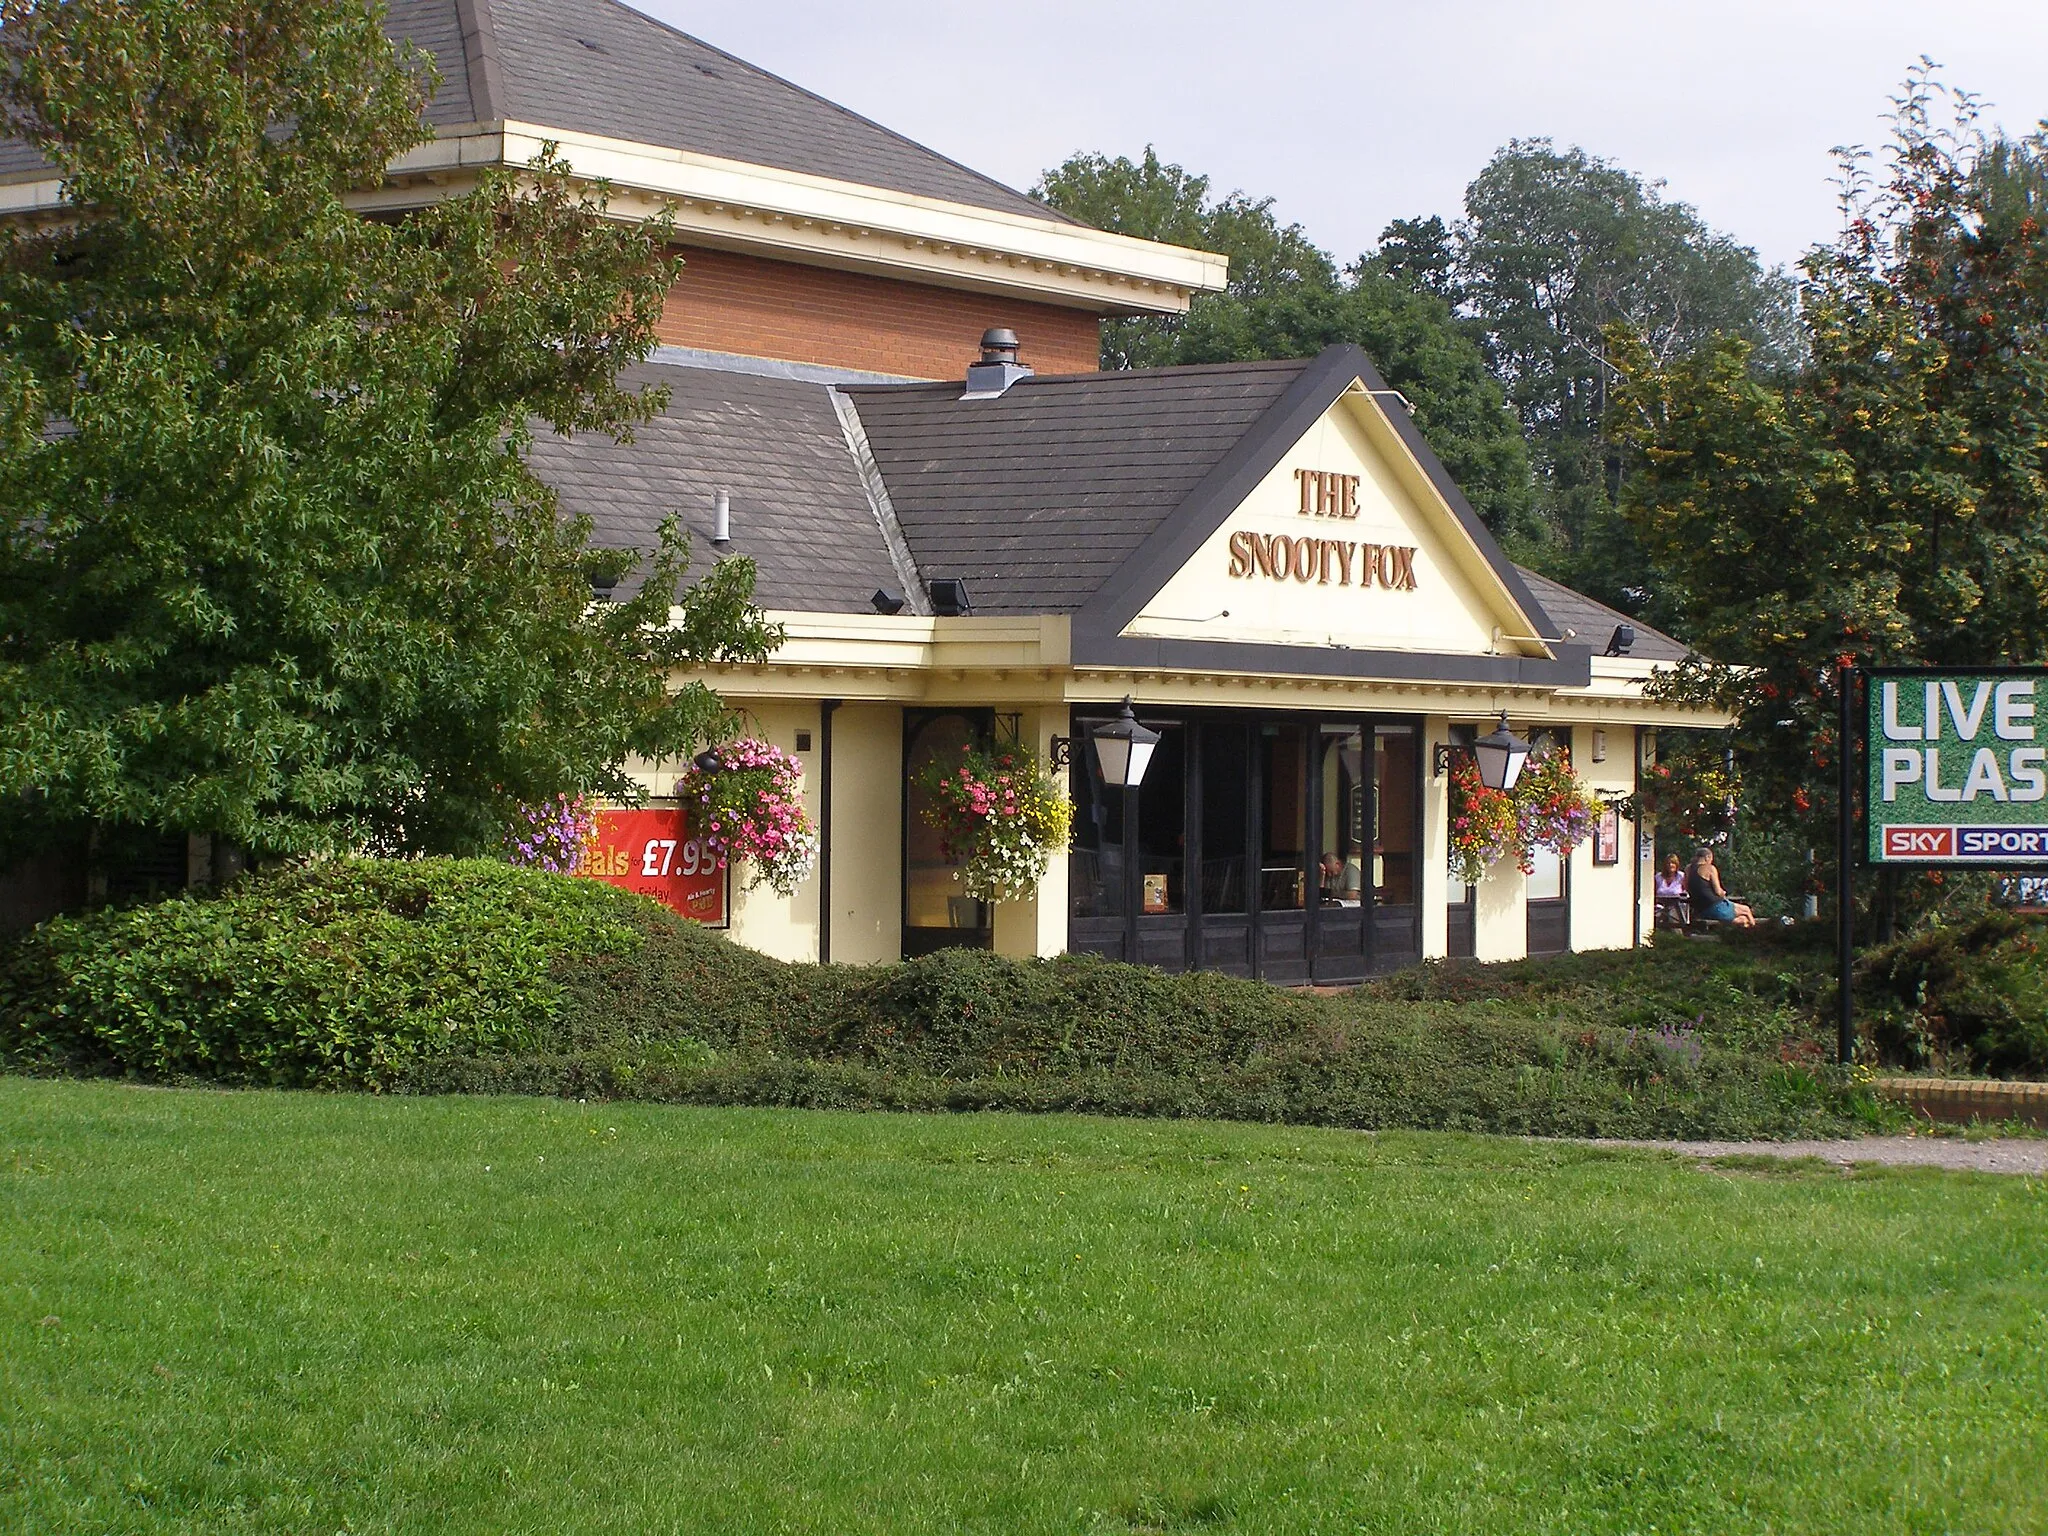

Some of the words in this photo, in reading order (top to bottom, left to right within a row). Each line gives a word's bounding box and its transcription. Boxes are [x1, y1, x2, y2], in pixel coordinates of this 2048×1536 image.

[1294, 468, 1361, 520] THE
[1229, 531, 1357, 587] SNOOTY
[1361, 543, 1418, 592] FOX
[1882, 681, 2035, 741] LIVE
[1882, 747, 2046, 803] PLAS
[570, 845, 629, 876] eals
[641, 838, 717, 876] £7.95
[1891, 832, 1947, 852] SKY
